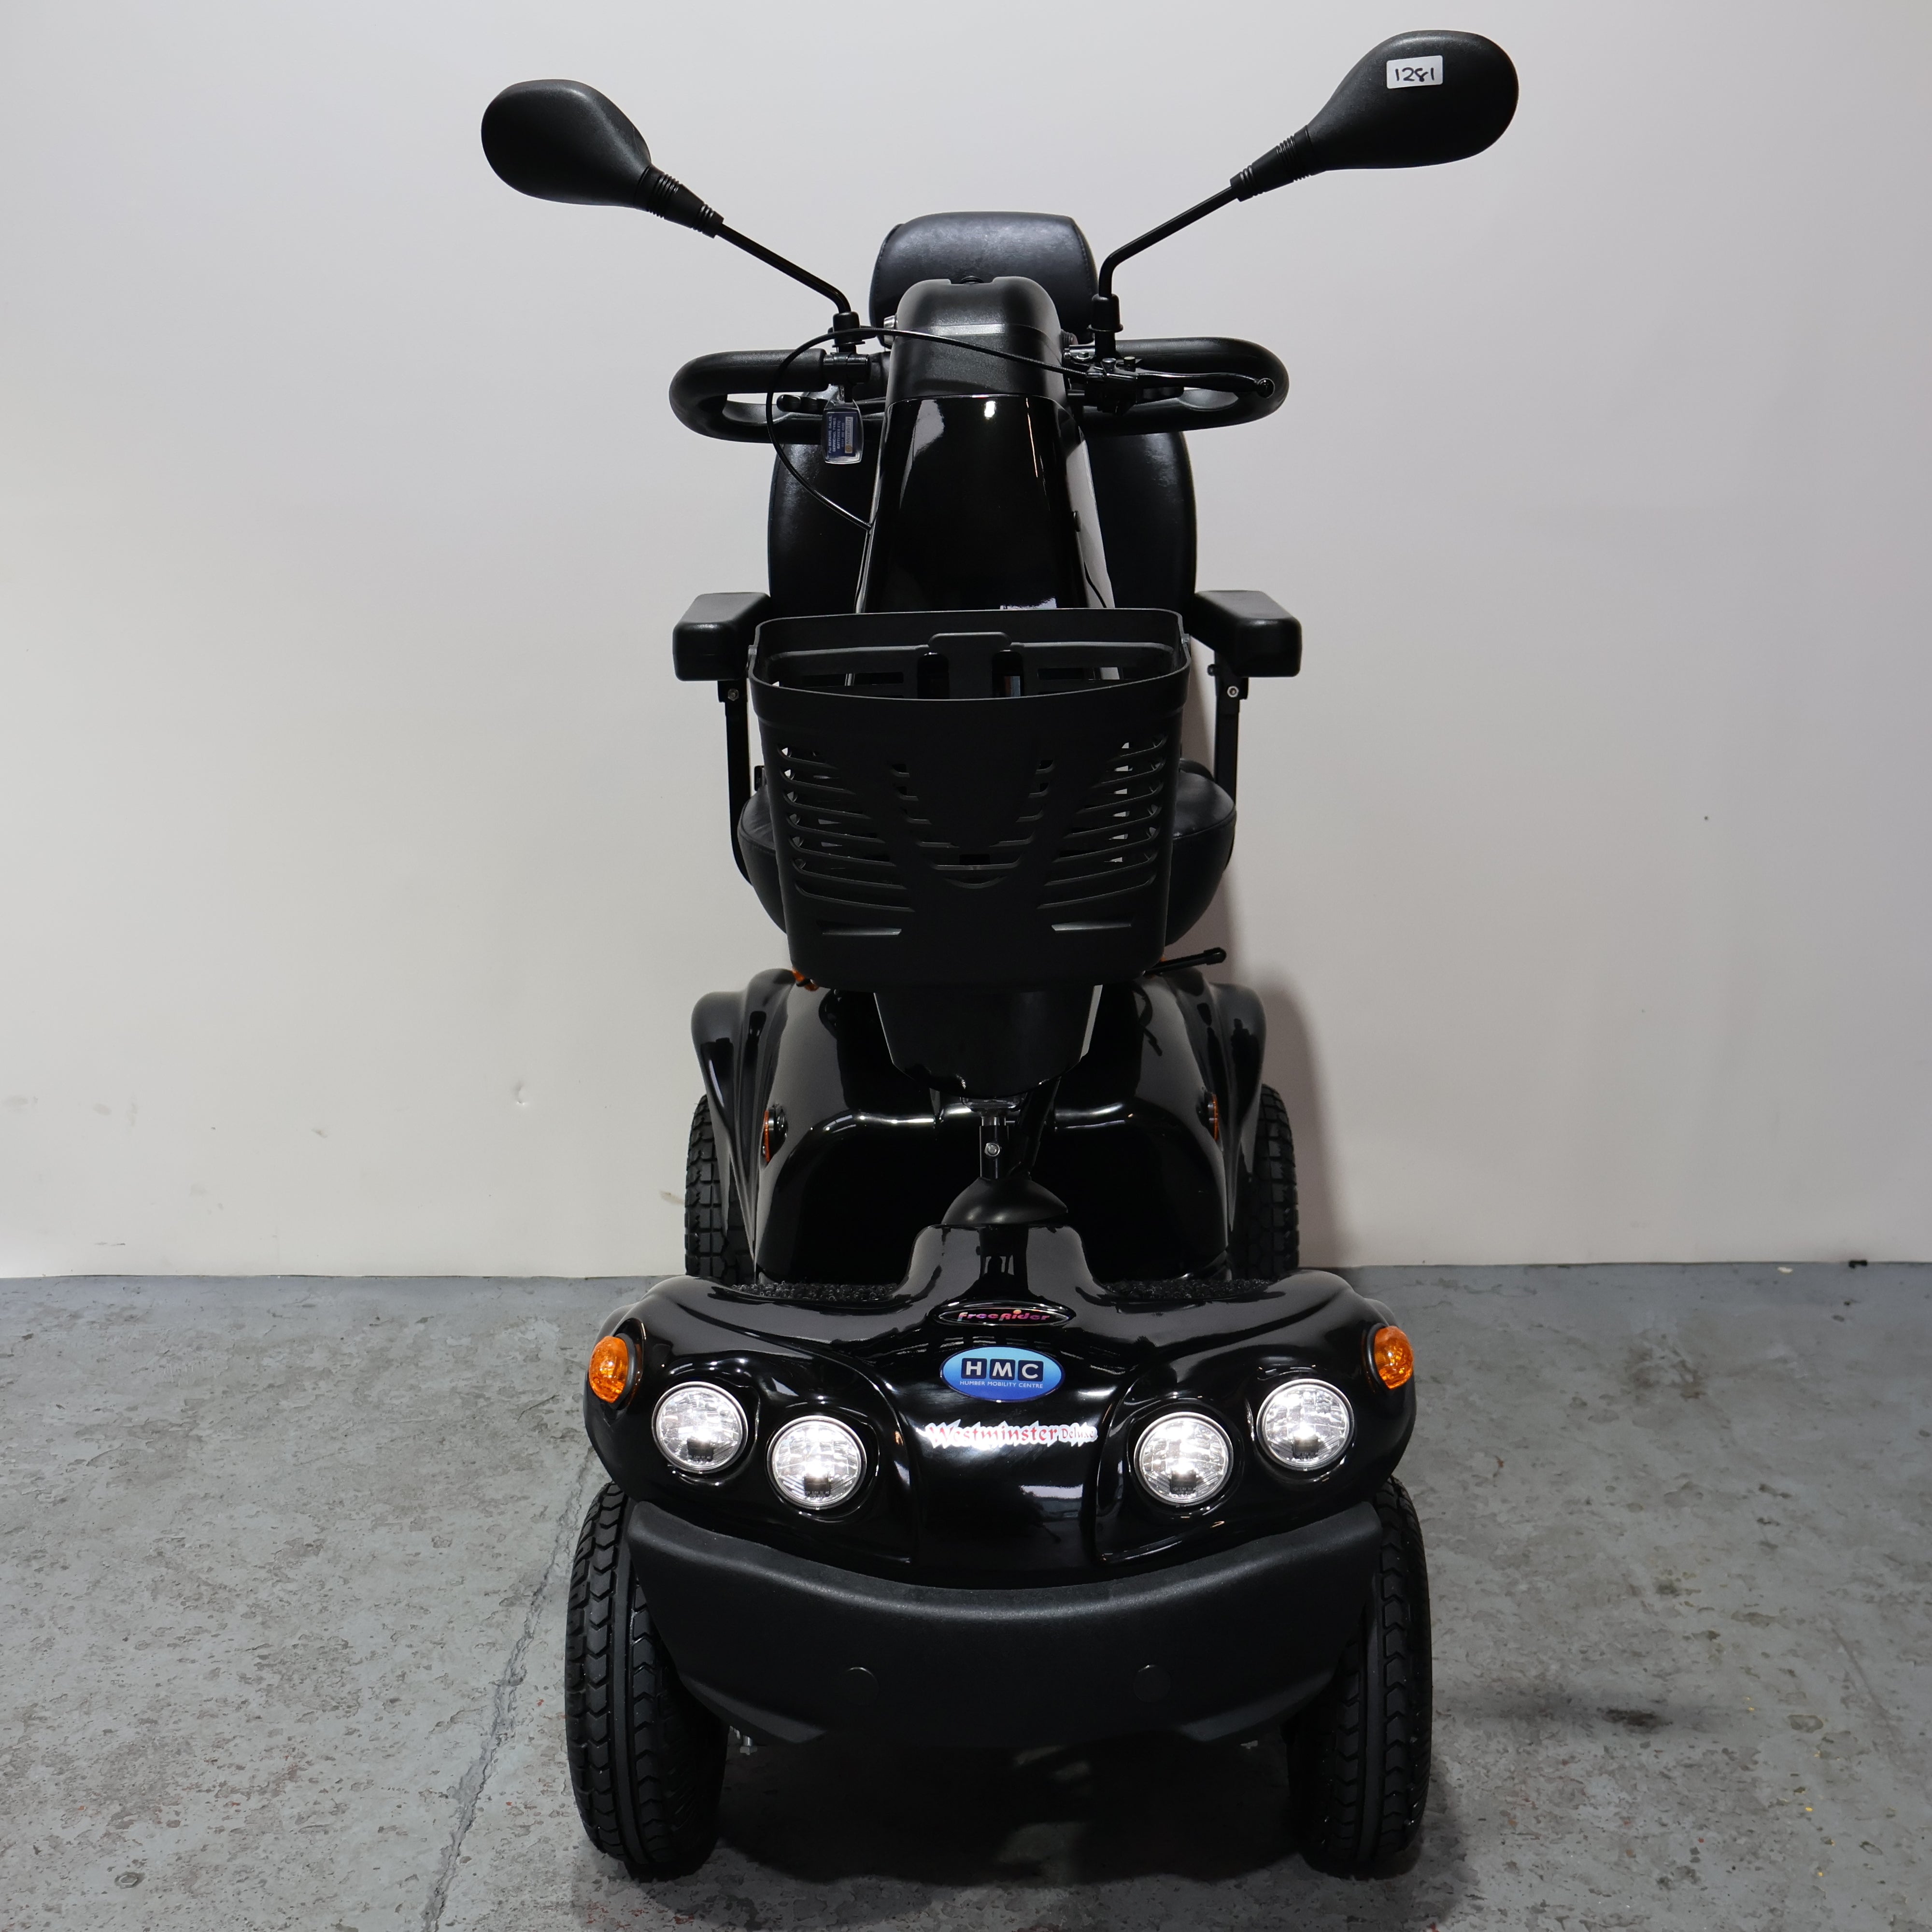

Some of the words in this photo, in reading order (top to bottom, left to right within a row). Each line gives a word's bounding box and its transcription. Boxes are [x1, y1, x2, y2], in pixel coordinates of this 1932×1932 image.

[1395, 67, 1435, 82] 1281
[929, 1425, 1058, 1443] Westminster
[1062, 1426, 1094, 1439] Deluxe
